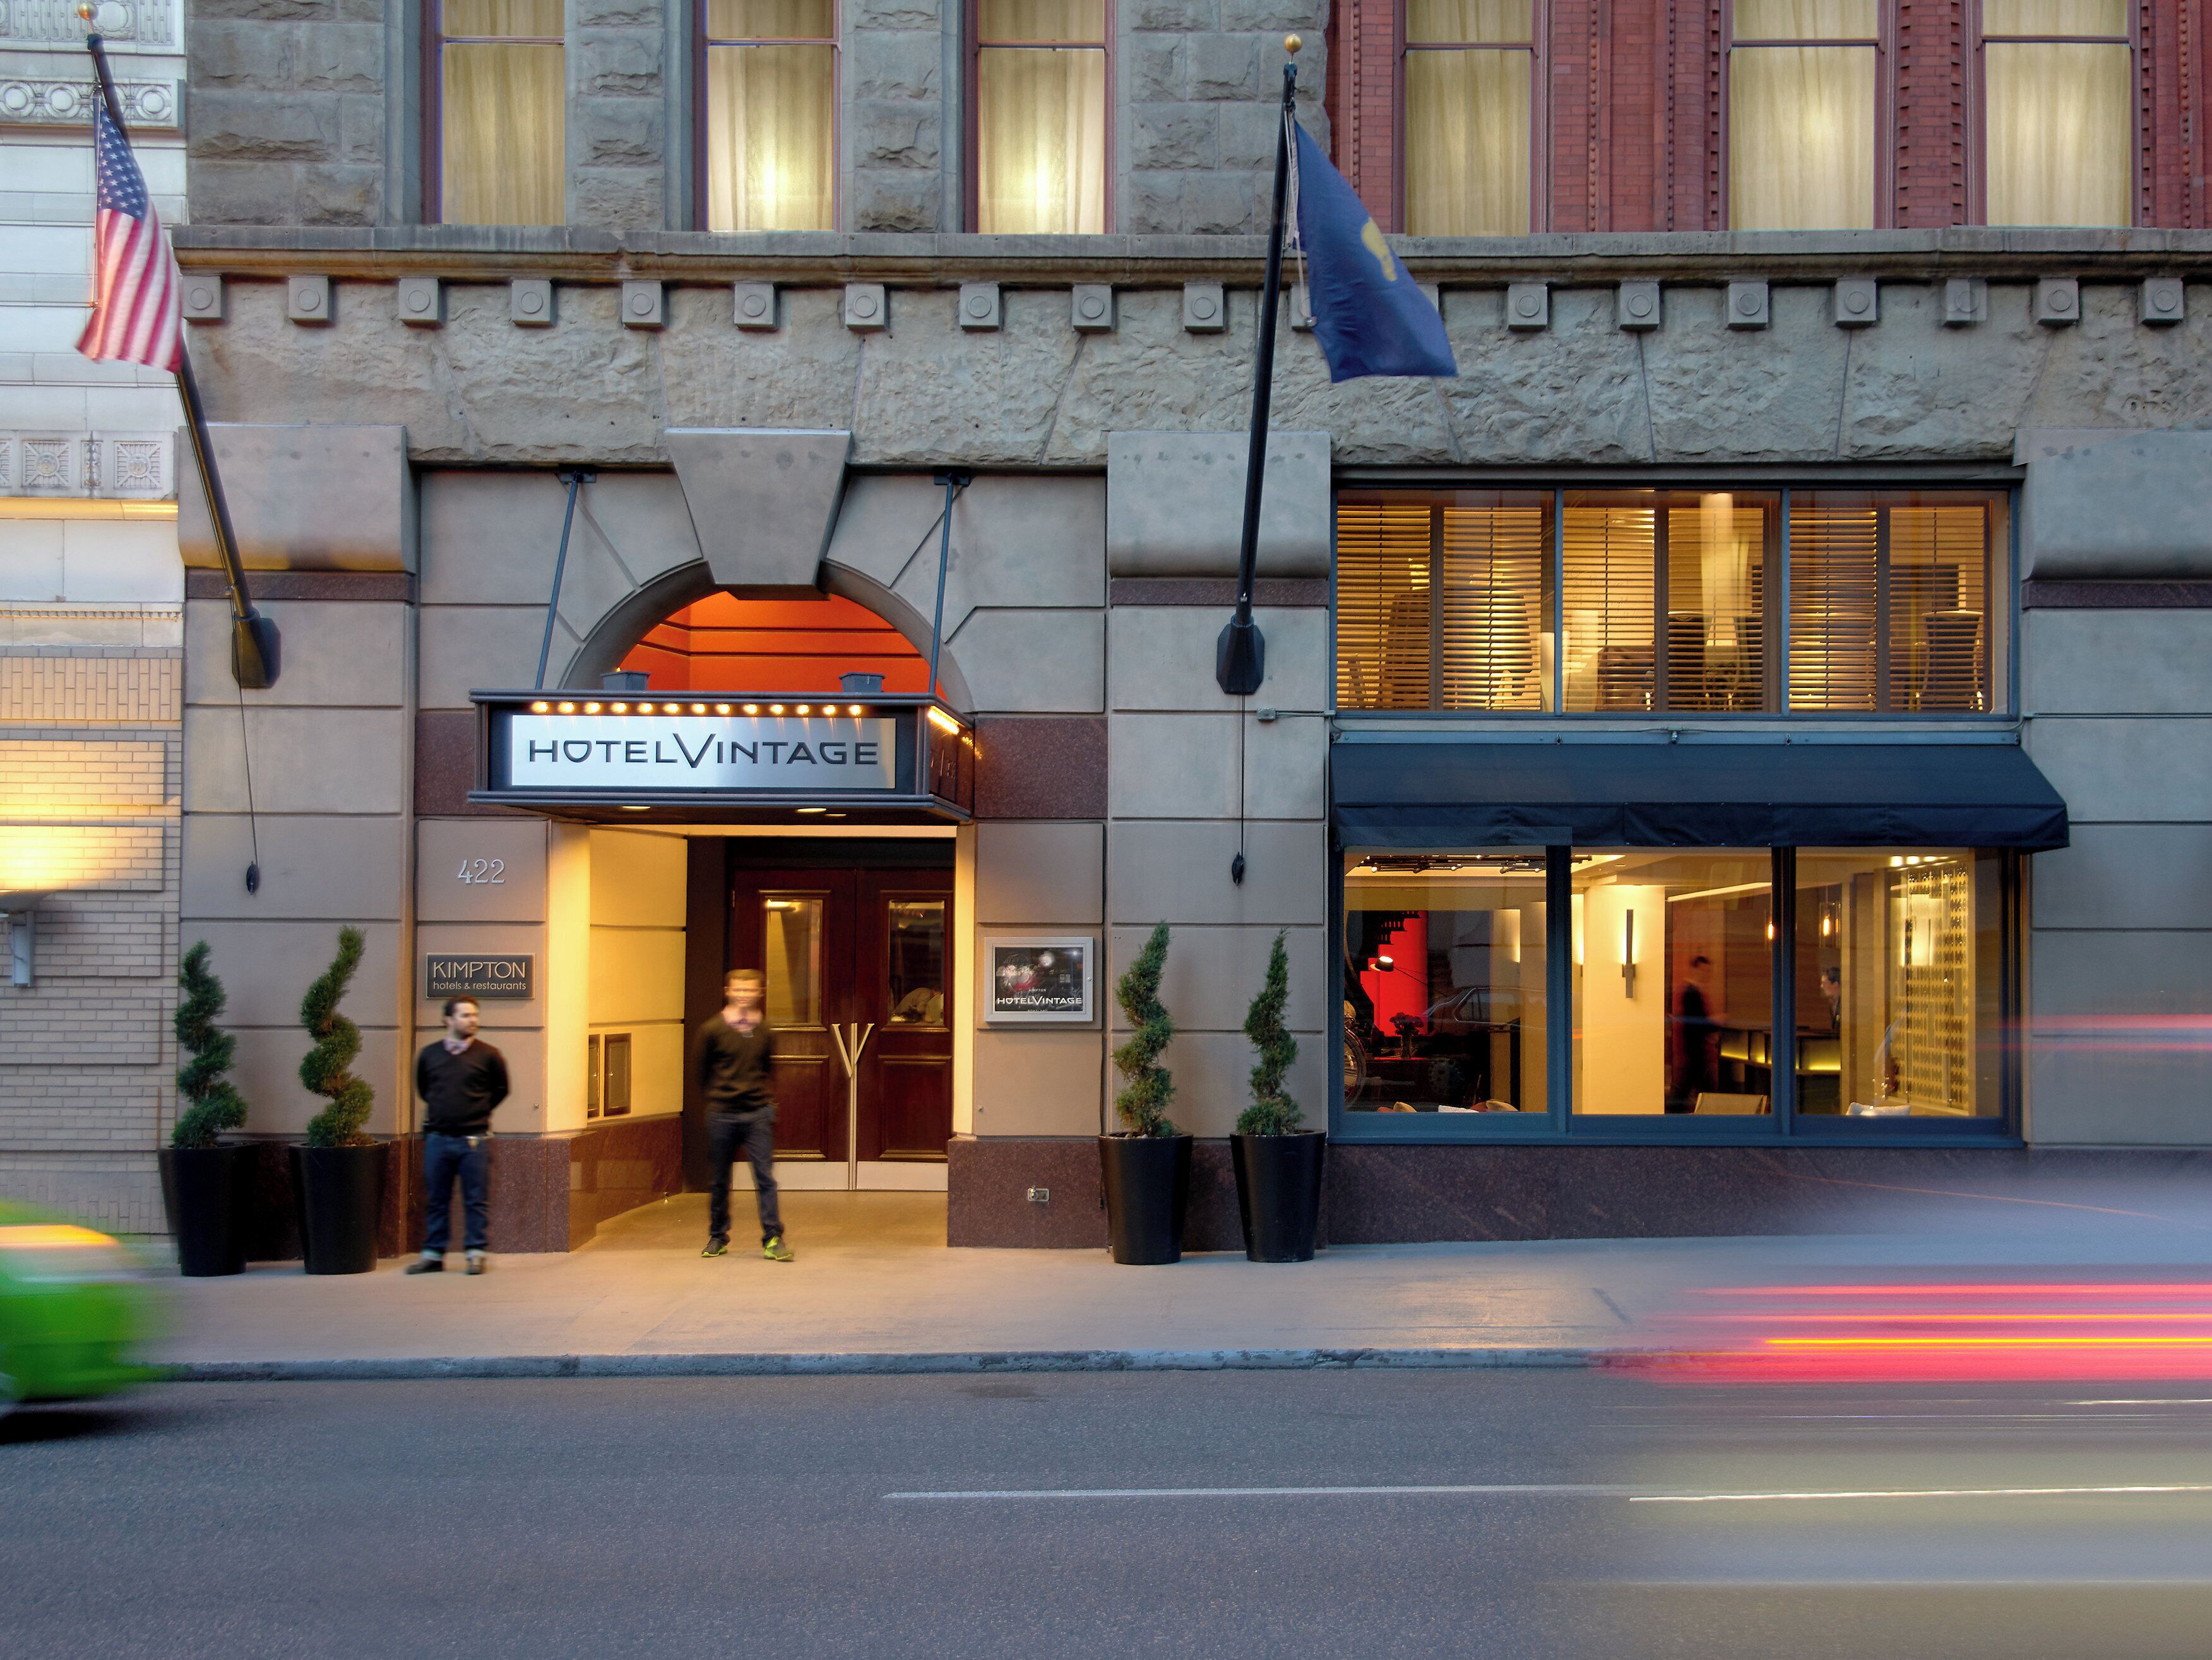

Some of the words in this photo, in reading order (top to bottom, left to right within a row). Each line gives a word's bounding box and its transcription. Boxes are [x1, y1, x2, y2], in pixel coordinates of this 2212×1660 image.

[458, 858, 505, 884] 422
[433, 961, 525, 978] KIMPTON
[433, 981, 461, 990] hotels
[464, 981, 470, 990] &
[473, 981, 526, 990] restaurants
